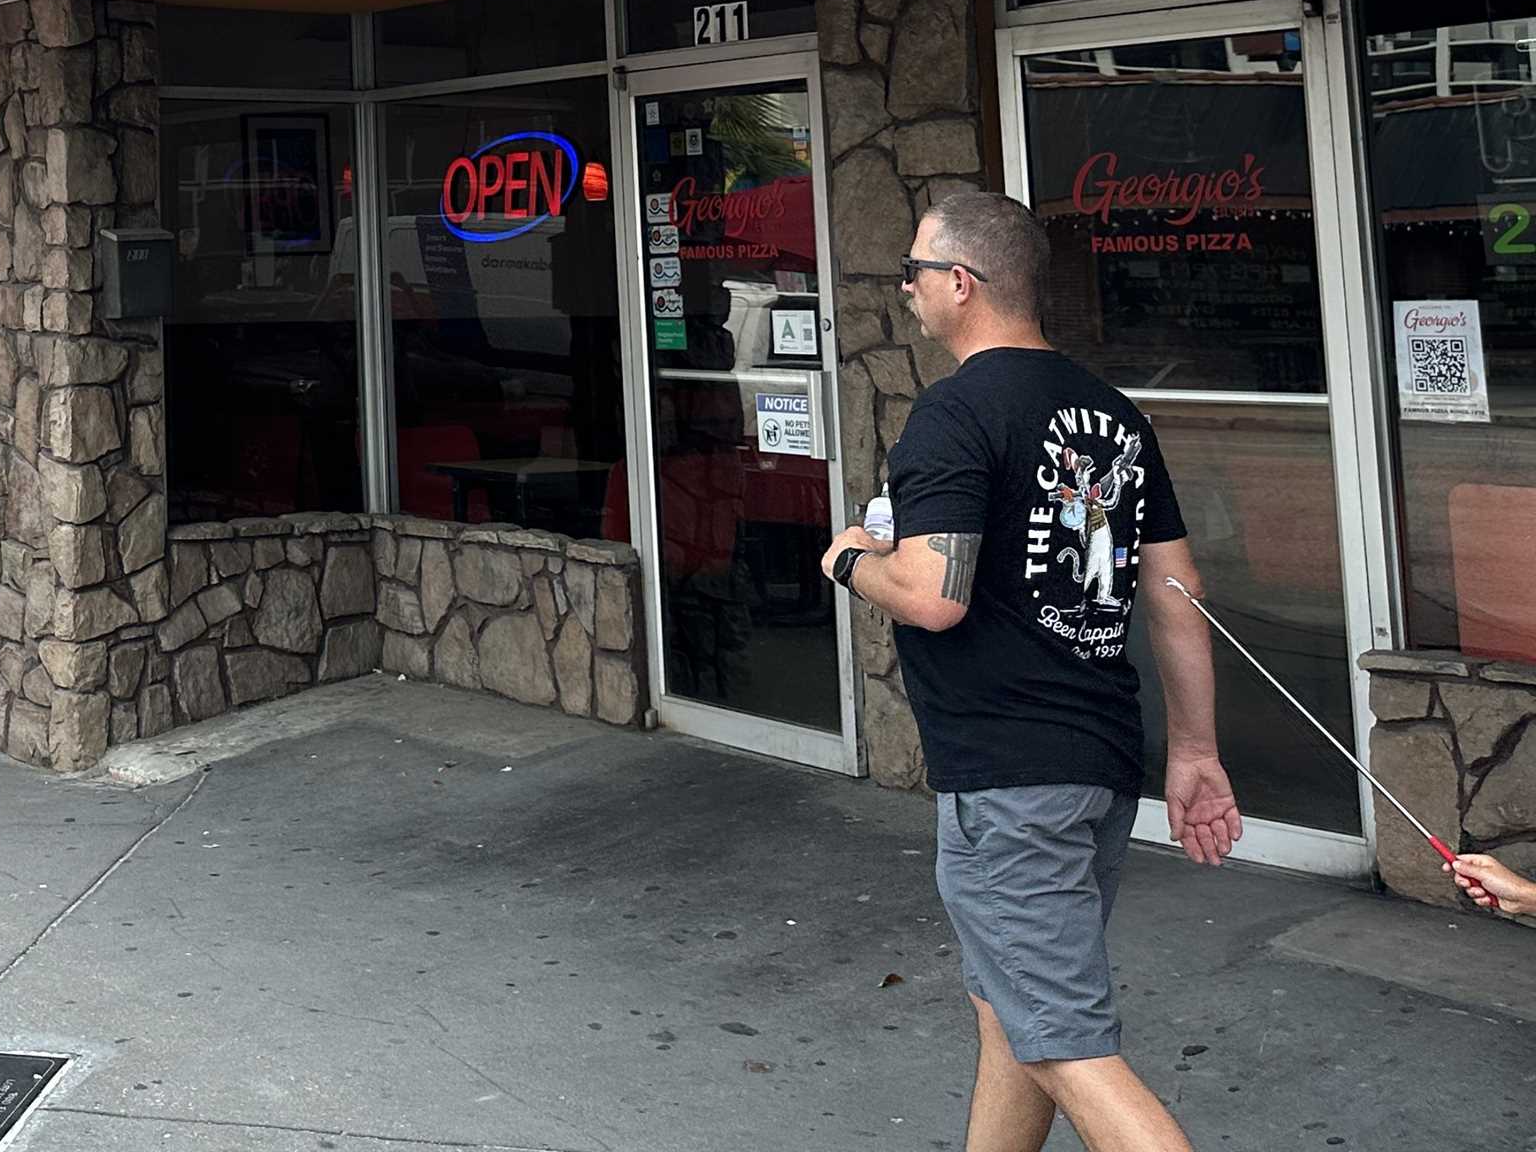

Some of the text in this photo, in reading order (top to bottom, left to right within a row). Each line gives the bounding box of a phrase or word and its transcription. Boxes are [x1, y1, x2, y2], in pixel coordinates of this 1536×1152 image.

[696, 4, 745, 45] 211
[443, 149, 562, 223] OPEN
[1072, 152, 1264, 226] Georgio's
[669, 176, 785, 236] Georgio's
[680, 244, 779, 259] FAMOUS PIZZA
[1091, 233, 1253, 253] FAMOUS PIZZA
[781, 319, 795, 339] A
[1404, 309, 1466, 333] Georgio's
[765, 398, 808, 411] NOTICE
[784, 429, 811, 438] ALLOWE
[1037, 420, 1064, 491] CAT
[1025, 506, 1054, 579] THE
[1037, 605, 1077, 640] Been
[1095, 644, 1123, 658] 1957
